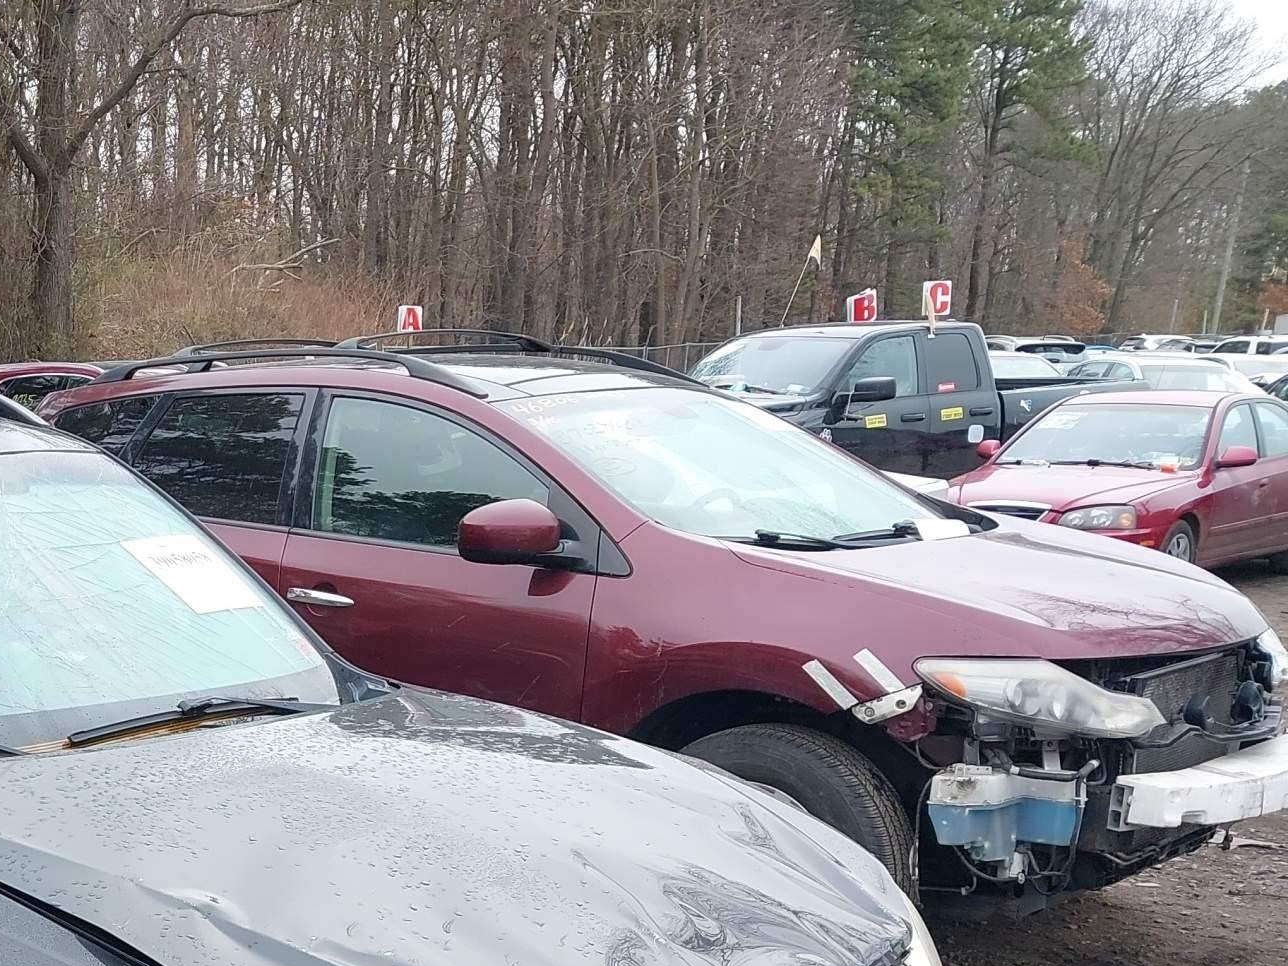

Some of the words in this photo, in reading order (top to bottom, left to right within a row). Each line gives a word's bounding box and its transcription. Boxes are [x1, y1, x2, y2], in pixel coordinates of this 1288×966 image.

[854, 293, 875, 322] B
[929, 282, 950, 314] C
[402, 307, 421, 331] A
